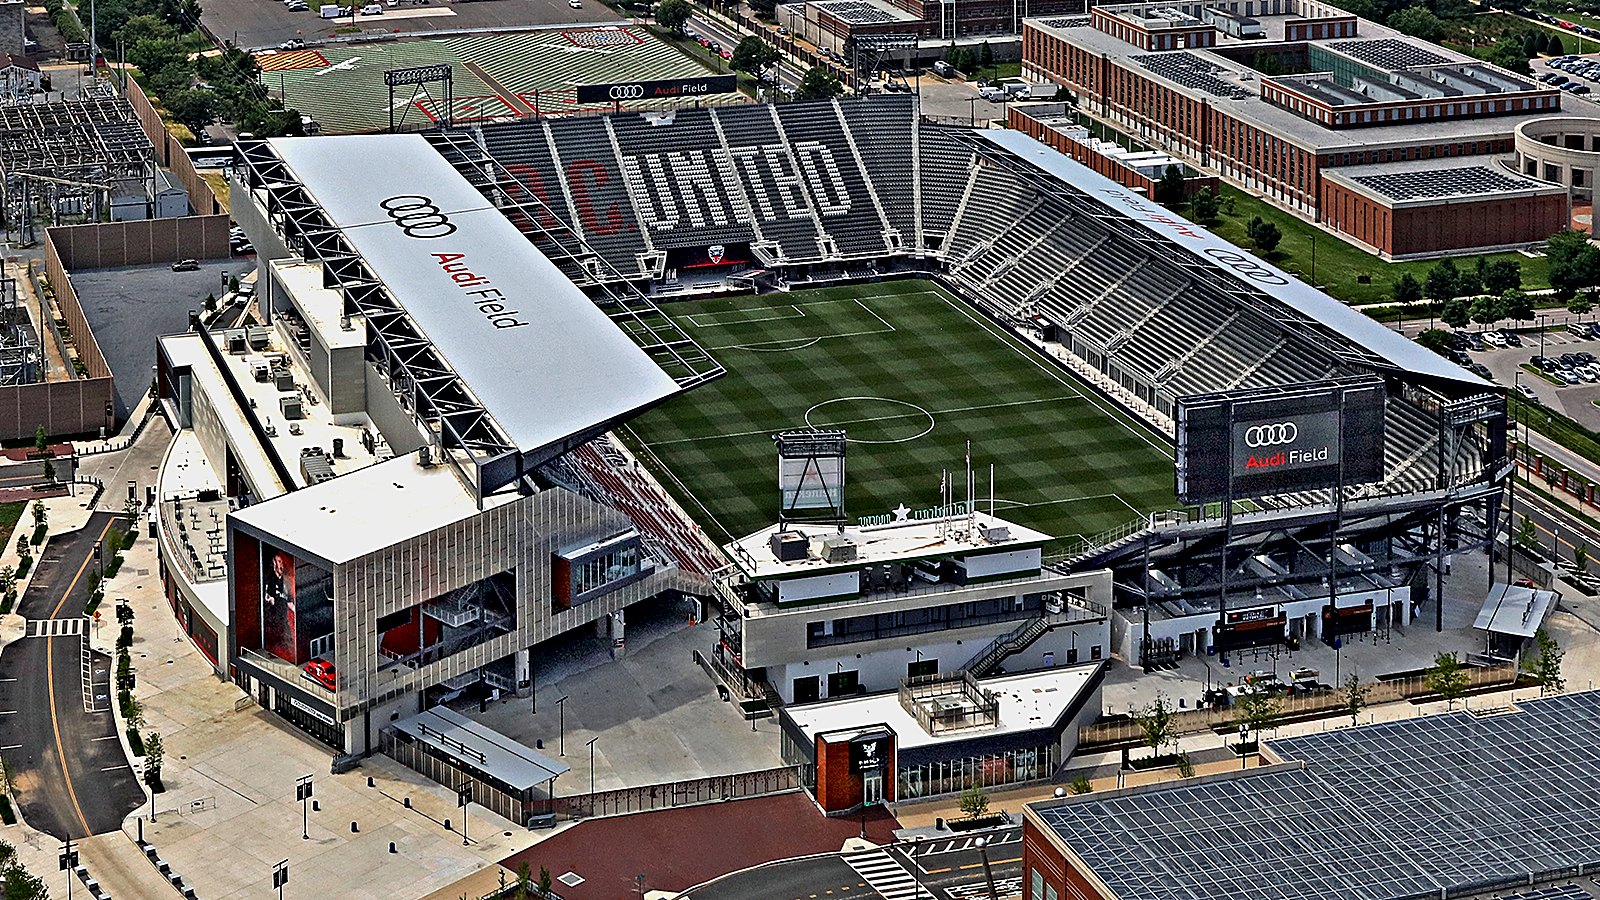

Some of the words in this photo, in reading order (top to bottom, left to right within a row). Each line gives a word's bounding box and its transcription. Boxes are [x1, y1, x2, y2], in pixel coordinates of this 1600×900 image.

[654, 86, 681, 95] Audi
[682, 83, 708, 93] Field
[622, 141, 852, 230] UNITED
[1099, 189, 1156, 213] Field
[1145, 214, 1206, 239] Audi
[430, 253, 491, 288] Audi
[465, 288, 530, 330] Field
[1245, 452, 1286, 469] Audi
[1289, 446, 1328, 464] Field
